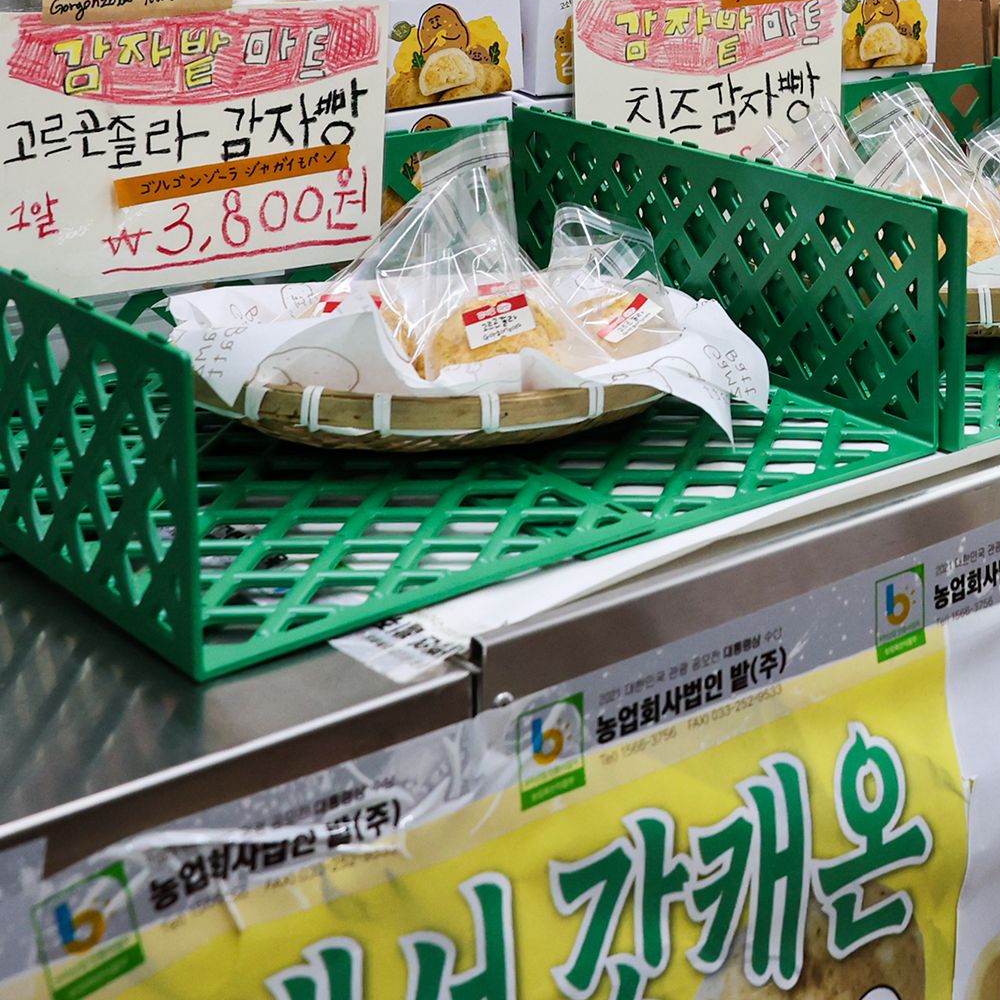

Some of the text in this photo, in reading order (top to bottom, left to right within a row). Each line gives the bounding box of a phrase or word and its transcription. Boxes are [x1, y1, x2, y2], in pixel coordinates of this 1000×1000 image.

[54, 25, 330, 95] 감자밭 마트
[616, 5, 753, 68] 감자밭
[3, 78, 368, 169] 고르곤졸라 감자빵
[7, 192, 59, 239] 1알
[596, 646, 787, 745] 농업회사법인 밭(주)
[621, 726, 677, 756] 1566-3756
